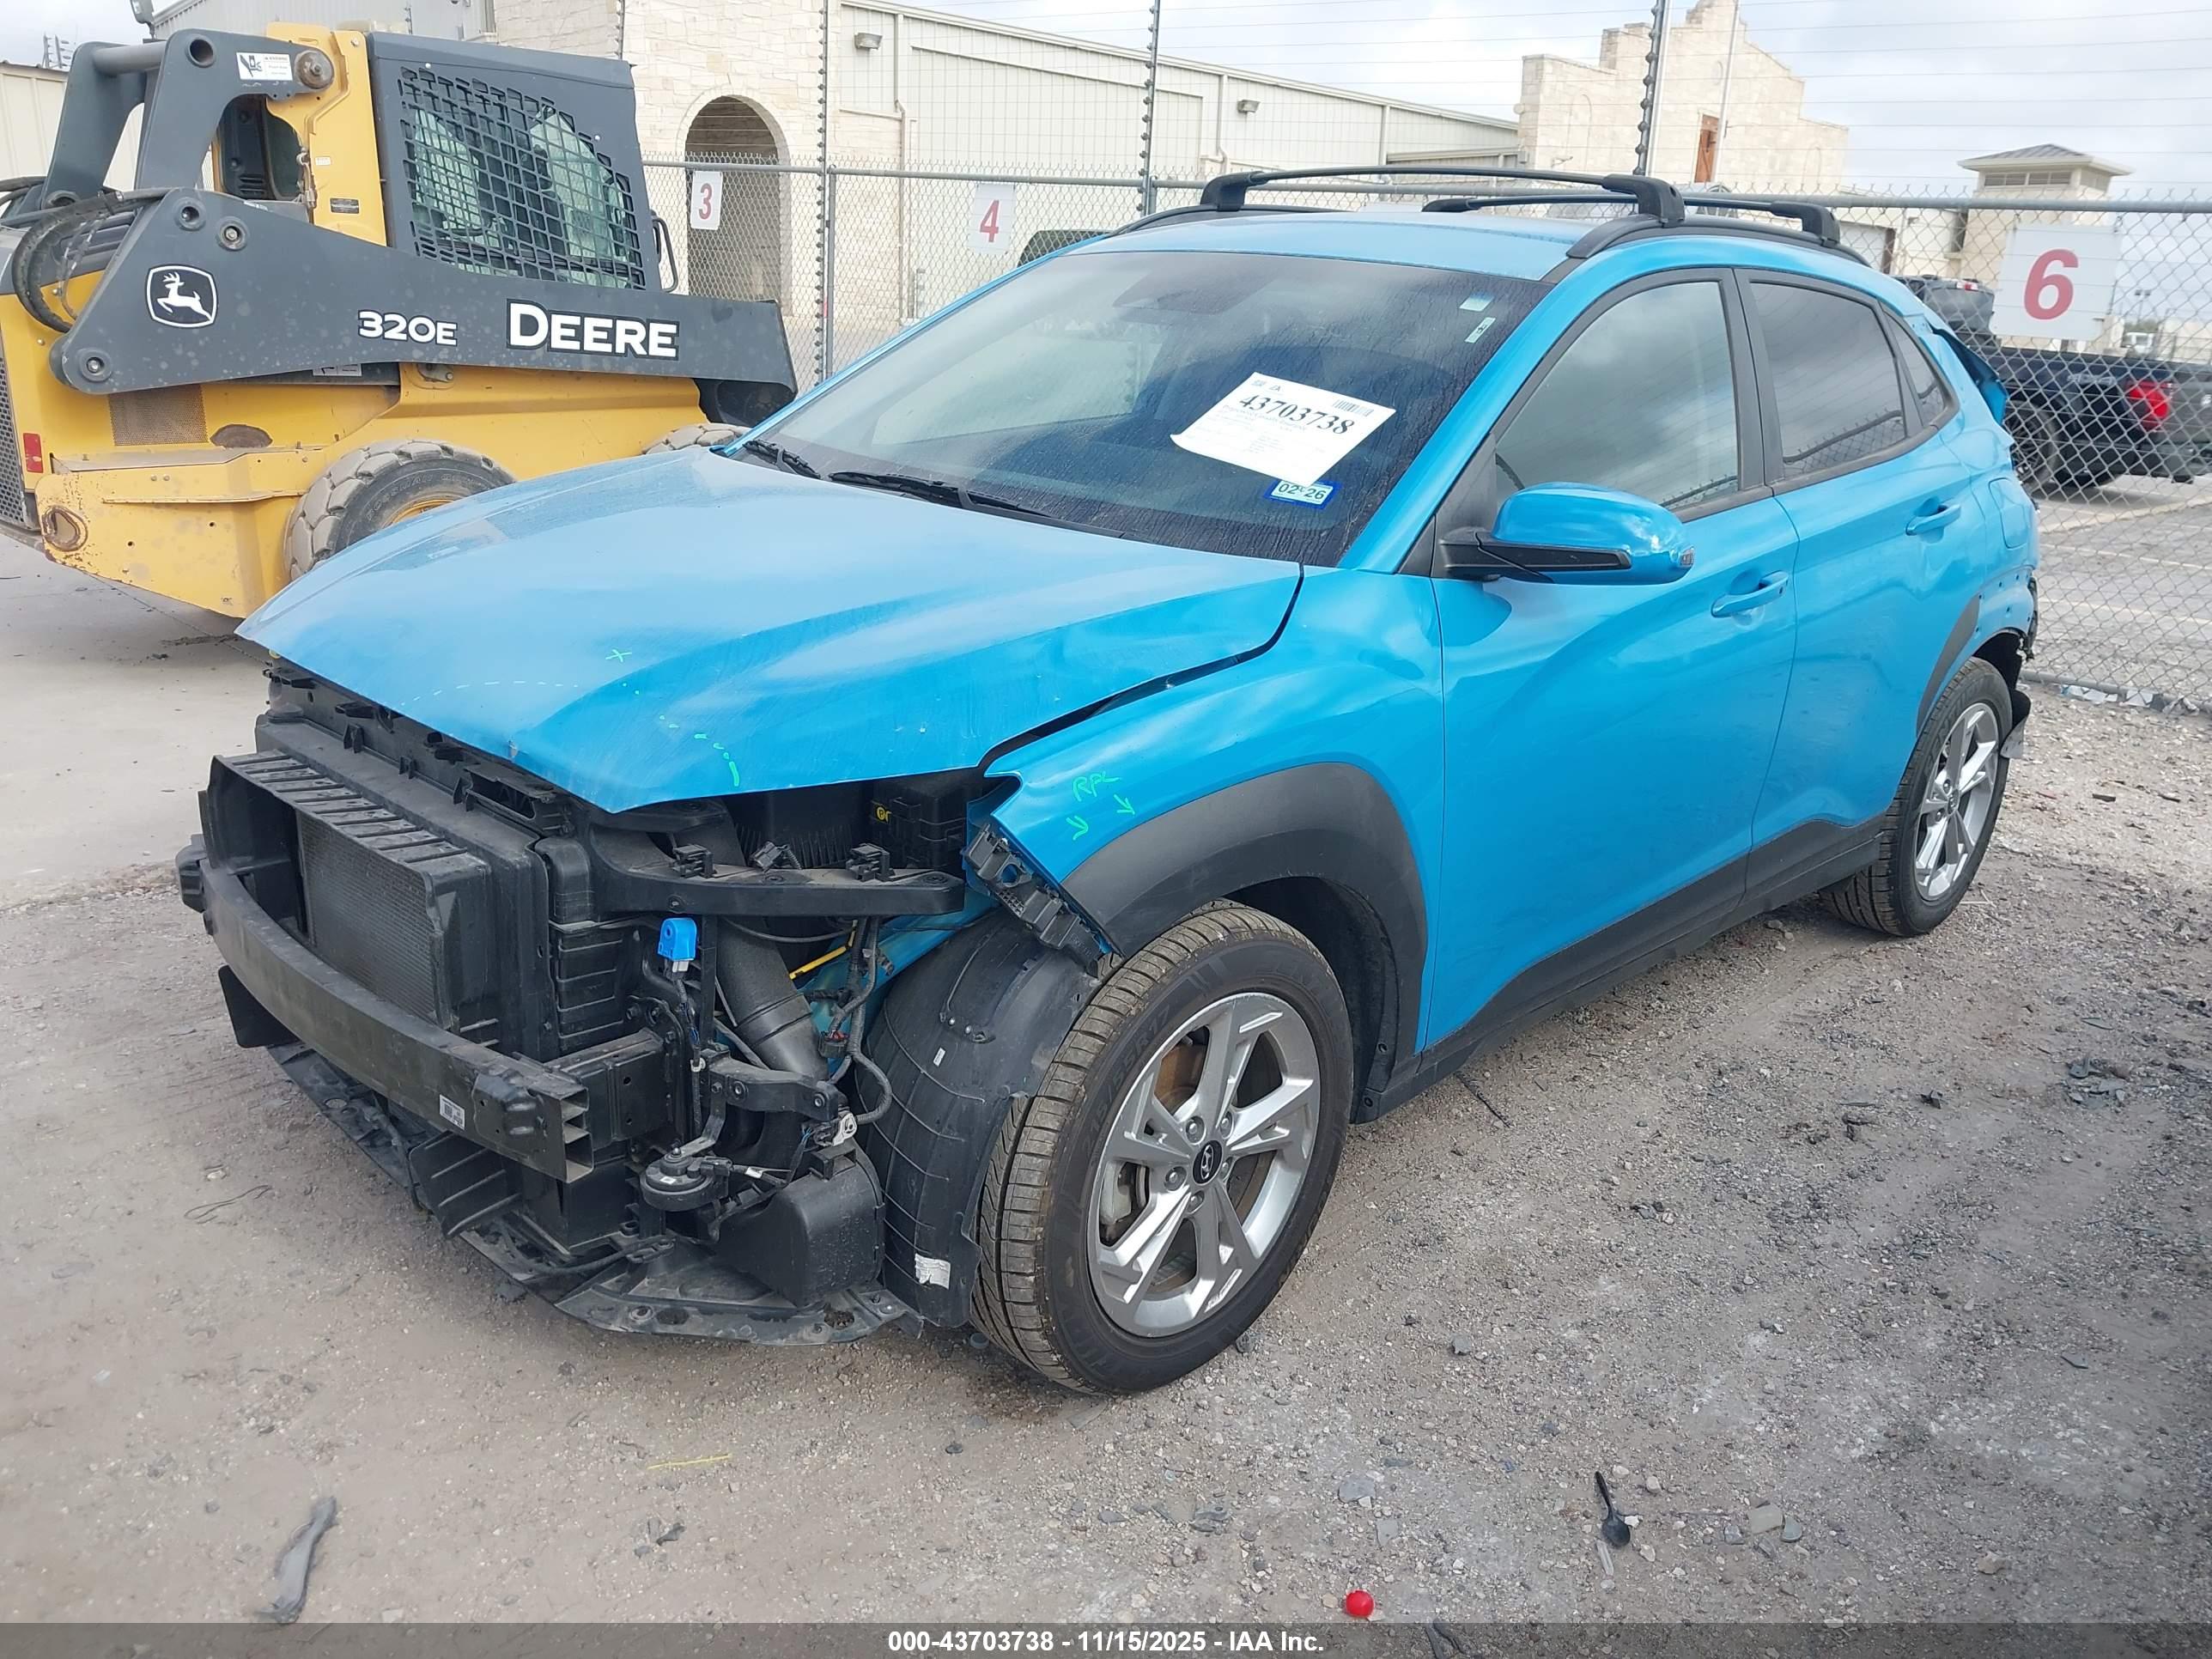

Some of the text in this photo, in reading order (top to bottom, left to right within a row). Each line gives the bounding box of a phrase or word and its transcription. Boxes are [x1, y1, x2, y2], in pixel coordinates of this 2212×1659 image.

[698, 182, 713, 220] 3
[979, 199, 1000, 242] 4
[2024, 248, 2079, 320] 6
[359, 310, 457, 345] 320E
[509, 302, 678, 357] DEERE
[1239, 394, 1355, 434] 43703738
[1304, 488, 1327, 500] 26
